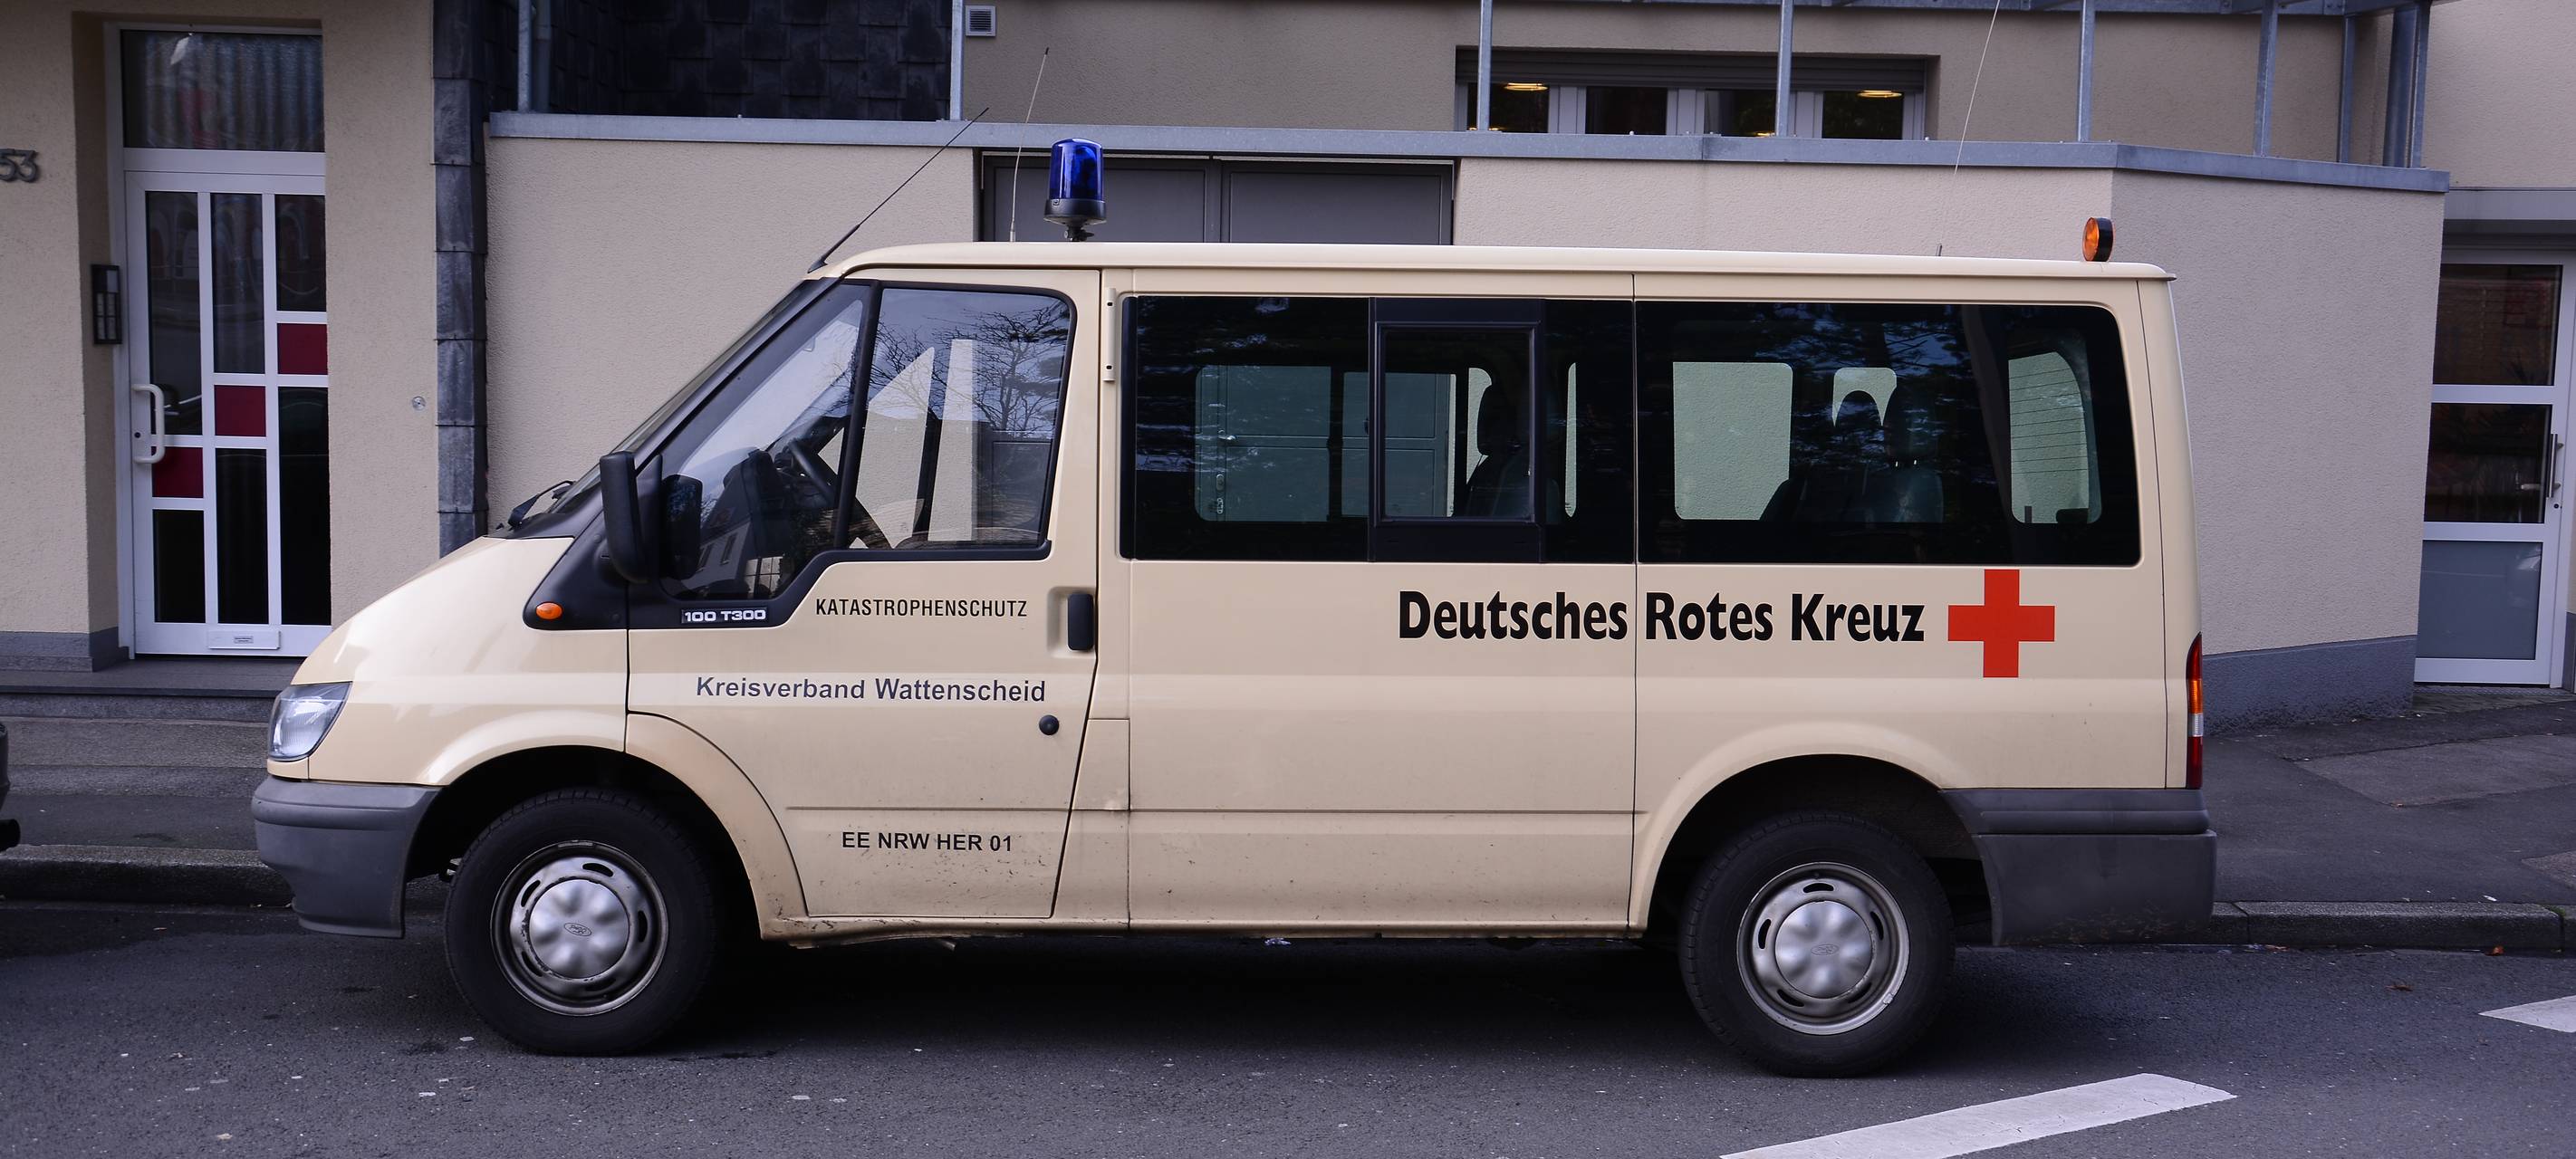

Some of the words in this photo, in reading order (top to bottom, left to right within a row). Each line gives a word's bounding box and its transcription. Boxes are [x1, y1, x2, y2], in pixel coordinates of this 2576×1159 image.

[0, 148, 41, 183] 53
[685, 611, 716, 622] 100
[721, 609, 766, 621] T300
[816, 599, 1027, 618] KATASTROPHENSCHUTZ
[1399, 591, 1628, 640] Deutsches
[1646, 592, 1773, 641] Rotes
[1792, 594, 1926, 642] Kreuz
[697, 676, 865, 699] Kreisverband
[876, 678, 1045, 702] Wattenscheid
[842, 831, 870, 848] EE
[878, 832, 930, 850] NRW
[937, 833, 983, 851] HER
[990, 835, 1011, 852] 01
